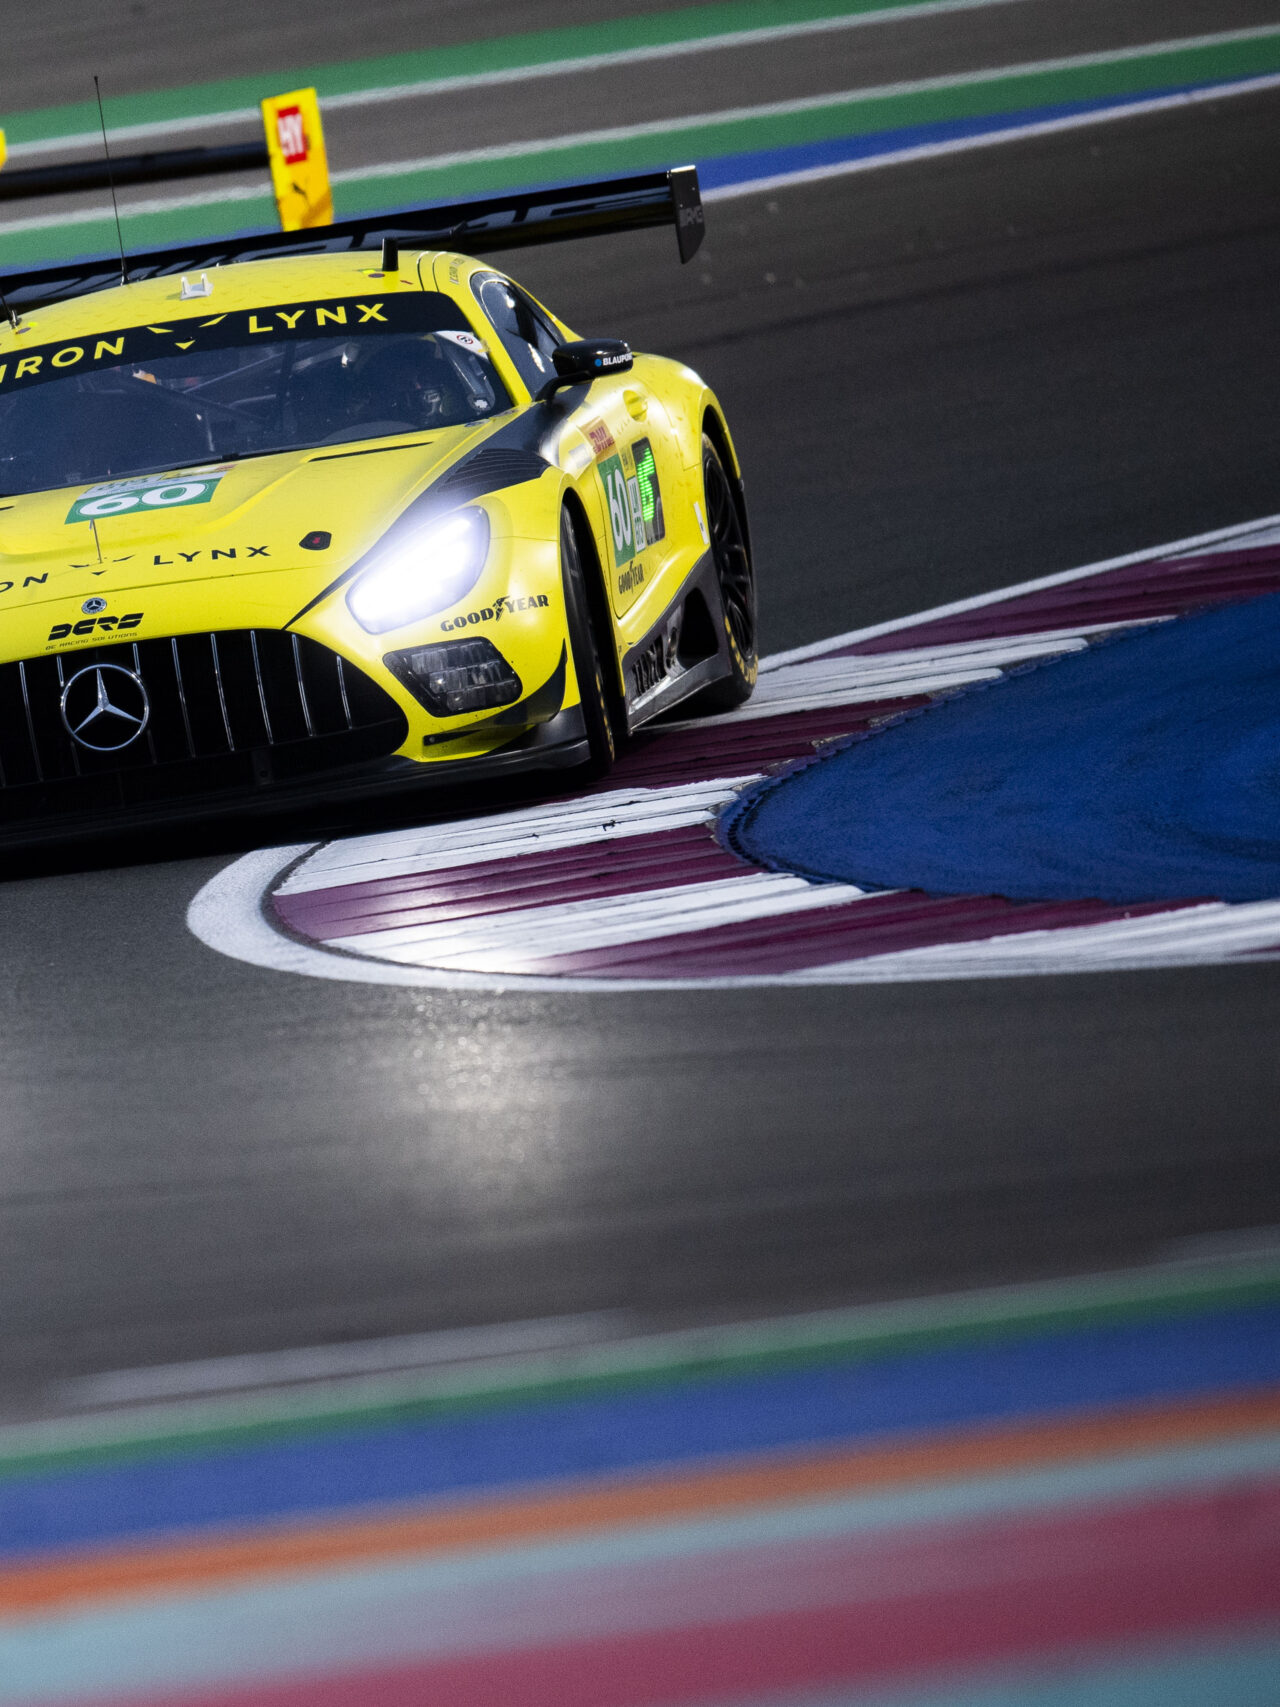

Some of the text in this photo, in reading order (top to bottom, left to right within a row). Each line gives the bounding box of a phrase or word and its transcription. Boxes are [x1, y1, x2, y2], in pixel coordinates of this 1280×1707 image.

[279, 113, 304, 157] HY
[249, 303, 388, 334] LYNX
[79, 483, 206, 516] 60
[607, 469, 632, 551] 60
[153, 545, 271, 566] LYNX
[618, 560, 644, 594] GOODYEAR
[440, 595, 549, 632] GOODYEAR
